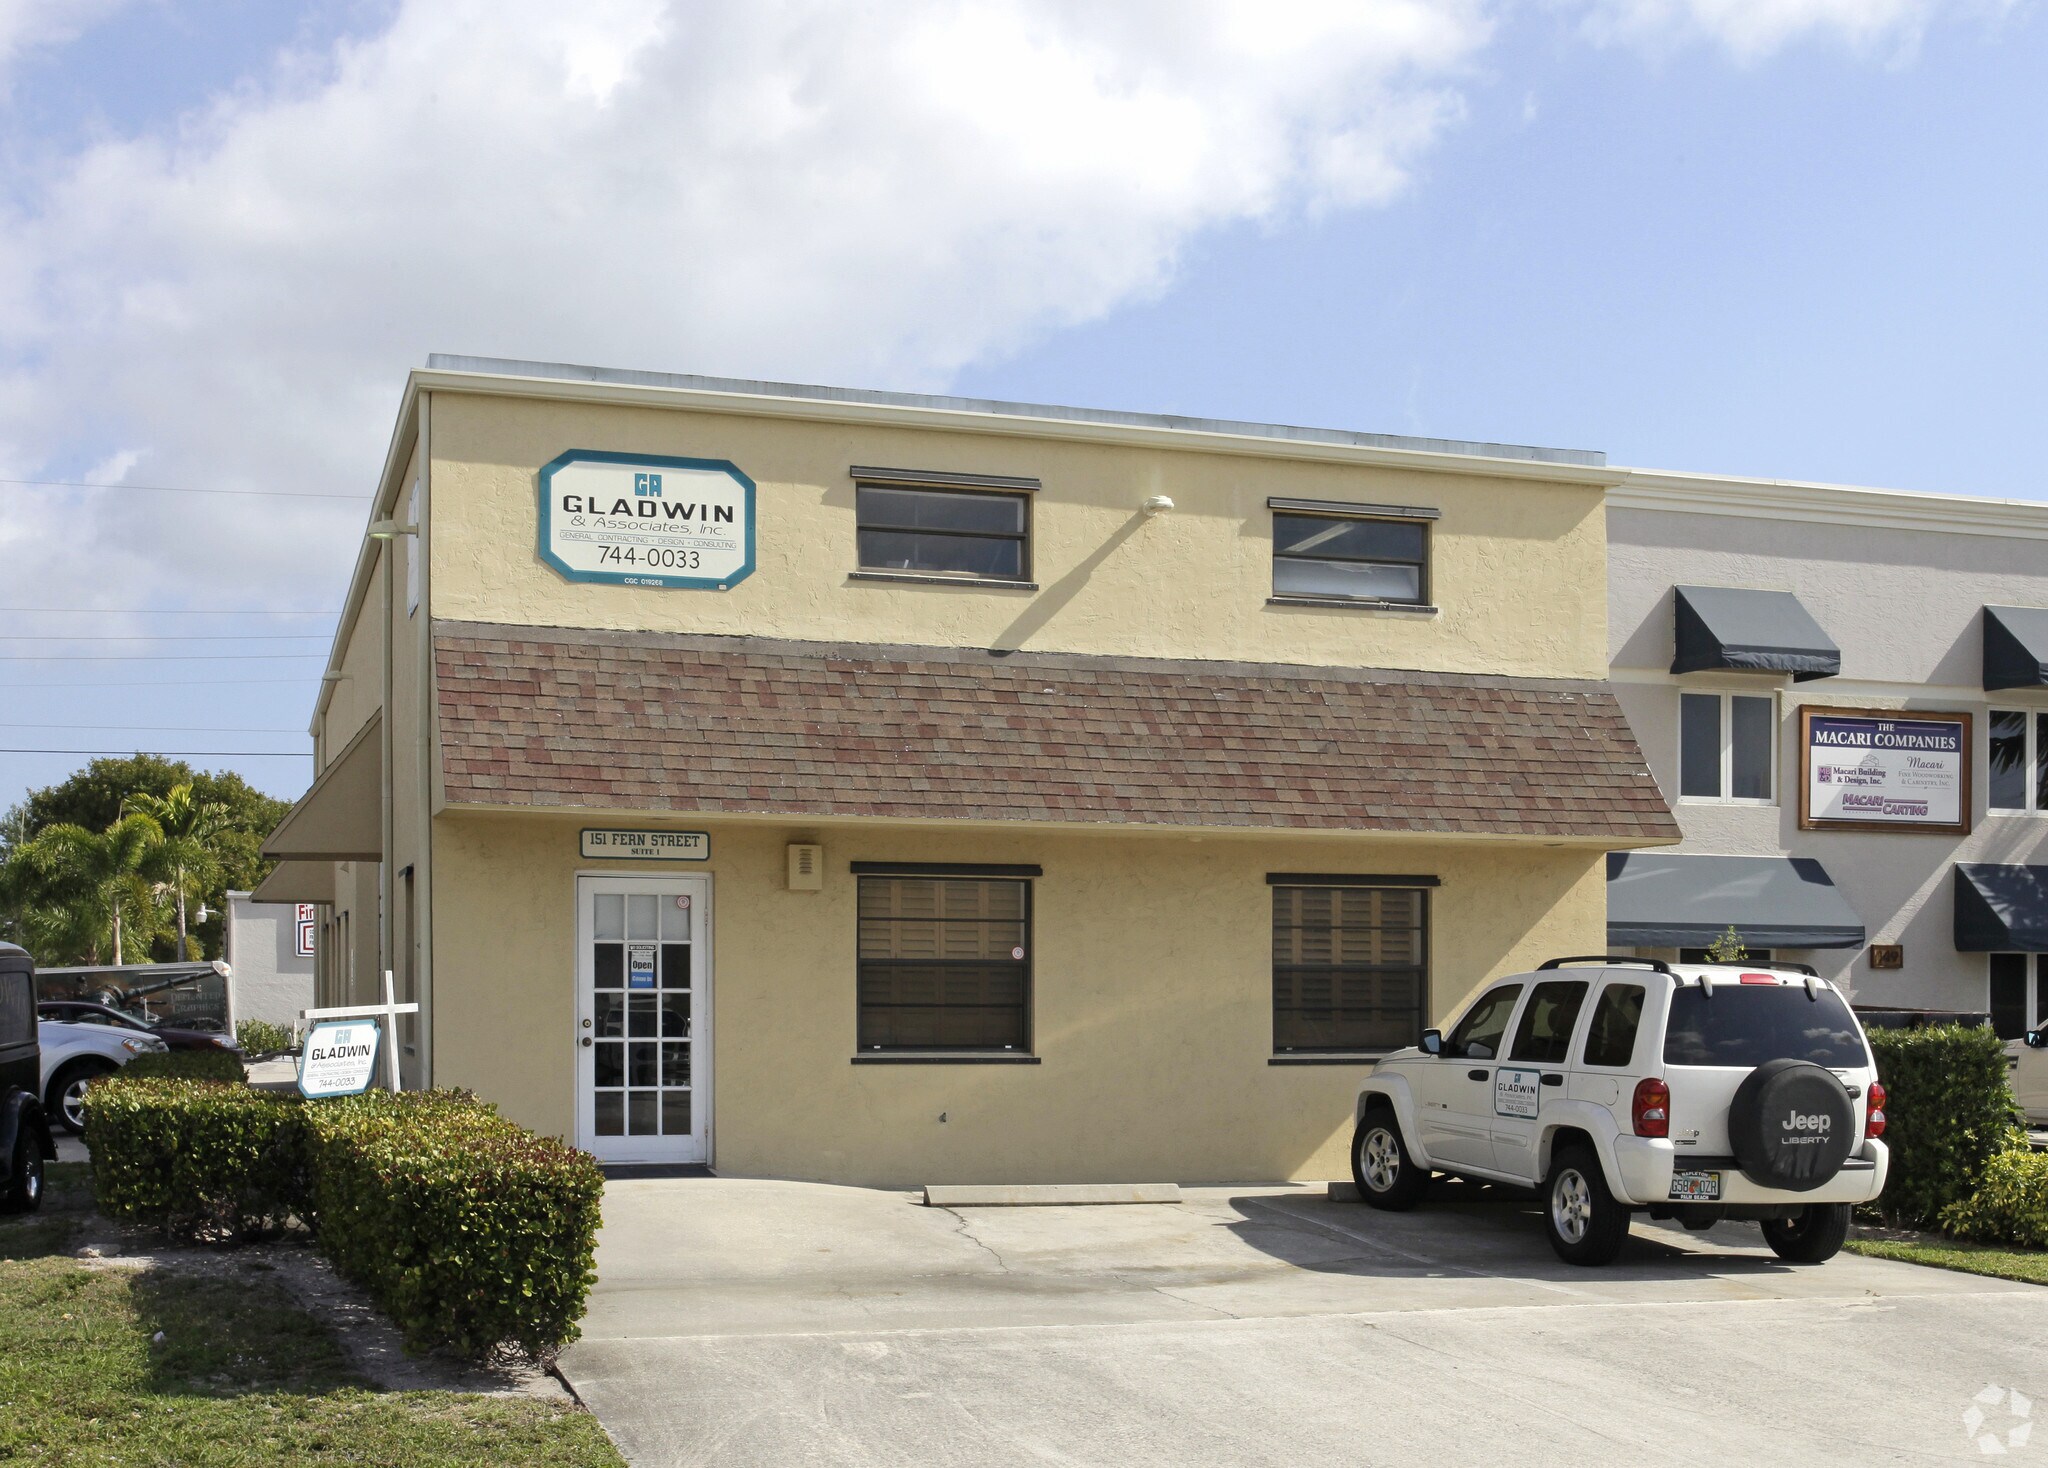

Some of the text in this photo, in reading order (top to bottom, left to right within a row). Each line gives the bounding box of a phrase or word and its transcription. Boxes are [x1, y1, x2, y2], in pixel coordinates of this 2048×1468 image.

[563, 494, 734, 523] GLADWIN
[570, 515, 726, 536] & Associates, Inc.
[559, 531, 737, 549] GENERAL CONTRACTING DESIGN CONSULTING
[598, 545, 700, 569] 744-0033
[624, 577, 639, 585] CGC
[1877, 723, 1895, 732] THE
[1815, 731, 1956, 749] MACARI COMPANIES
[1906, 755, 1946, 770] Macari
[1833, 766, 1887, 778] Macari Building
[1836, 775, 1883, 786] & Design, Inc.
[1842, 793, 1884, 807] MACARI
[1882, 803, 1929, 816] CARTING
[590, 833, 700, 848] 151 FERN STREET
[630, 848, 654, 856] SUITE
[632, 960, 653, 970] Open
[312, 1044, 371, 1060] GLADWIN
[318, 1076, 356, 1088] 744-0033
[1498, 1083, 1536, 1094] GLADWIN
[1782, 1109, 1831, 1134] Jeep
